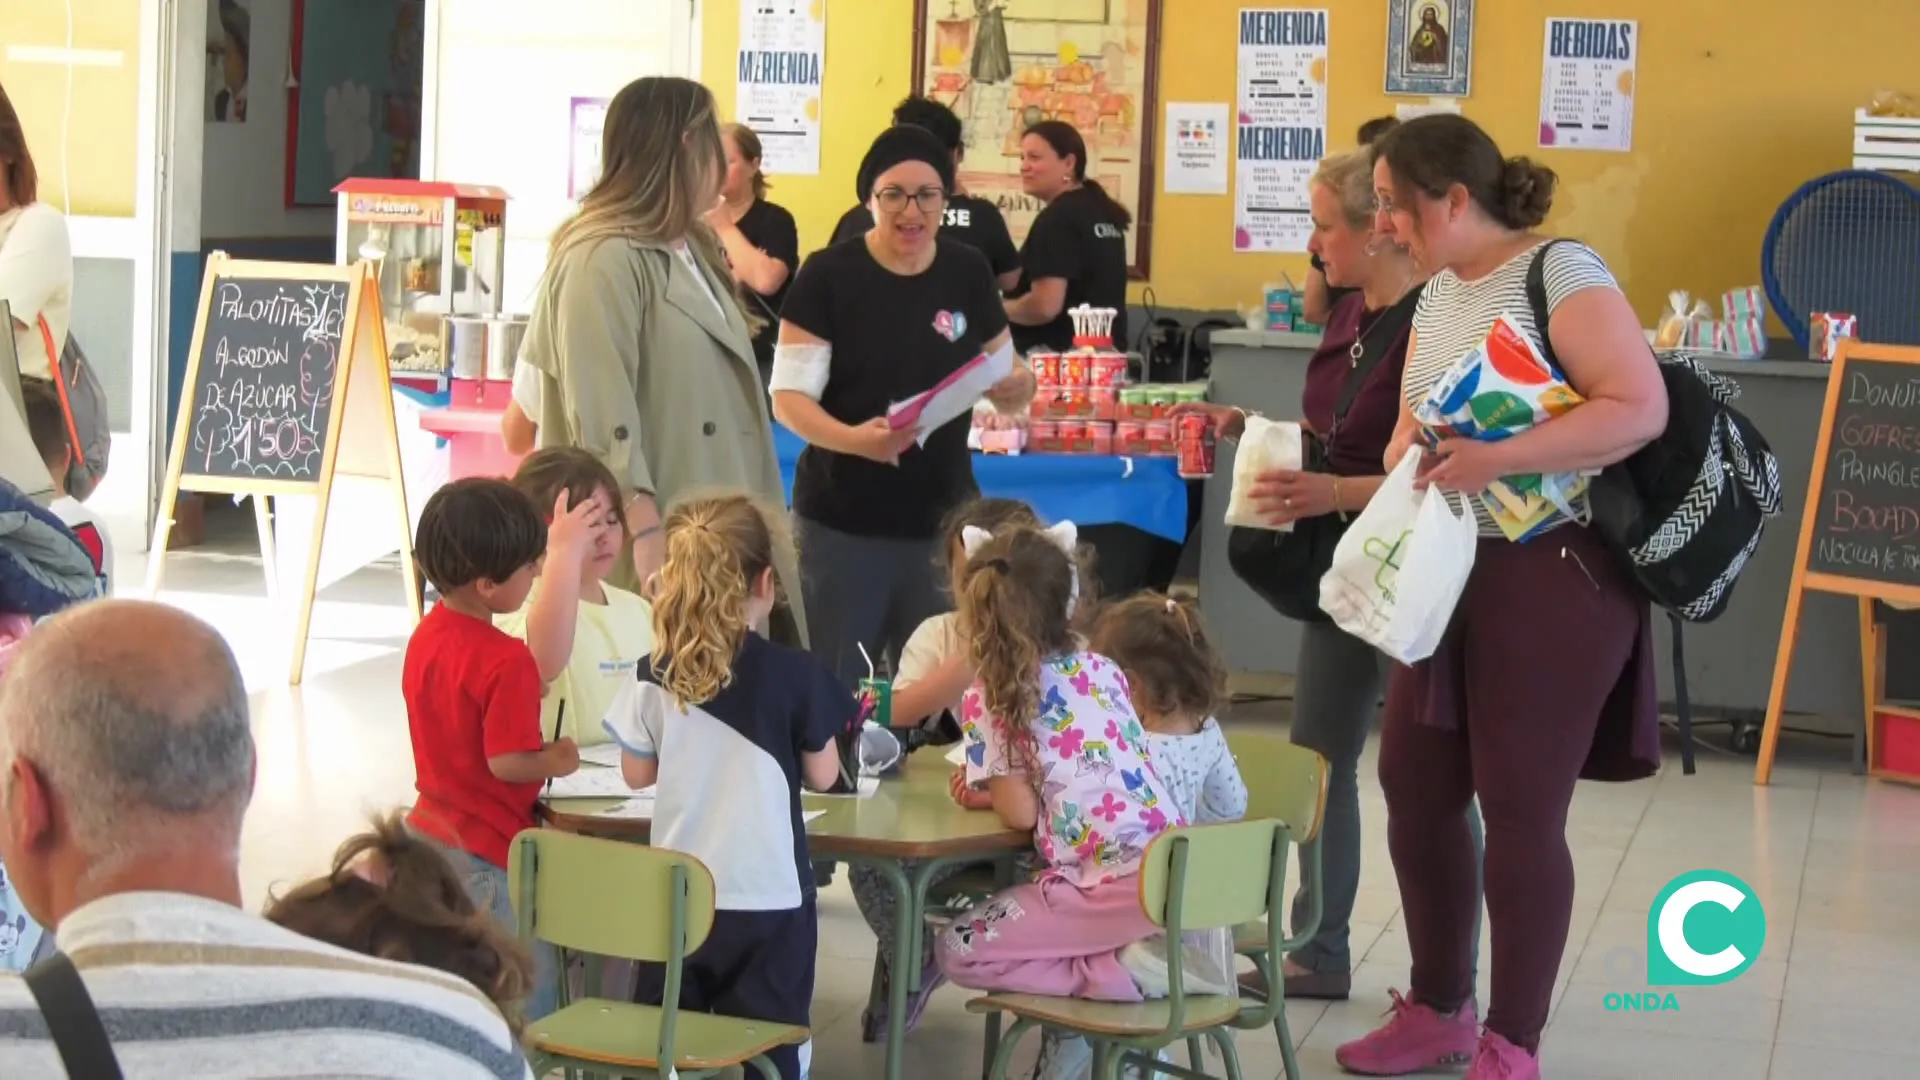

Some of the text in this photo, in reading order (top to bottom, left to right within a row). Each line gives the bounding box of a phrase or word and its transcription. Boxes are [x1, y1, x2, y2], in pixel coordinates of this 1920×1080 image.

[1240, 11, 1326, 45] MERIENDA
[1550, 21, 1631, 60] BEBIDAS
[739, 50, 819, 85] MERIENDA
[1238, 126, 1323, 160] MERIENDA
[219, 283, 311, 327] PALOMITAS
[215, 336, 289, 379] ALGODÓN
[206, 373, 297, 416] DE AZÚCAR
